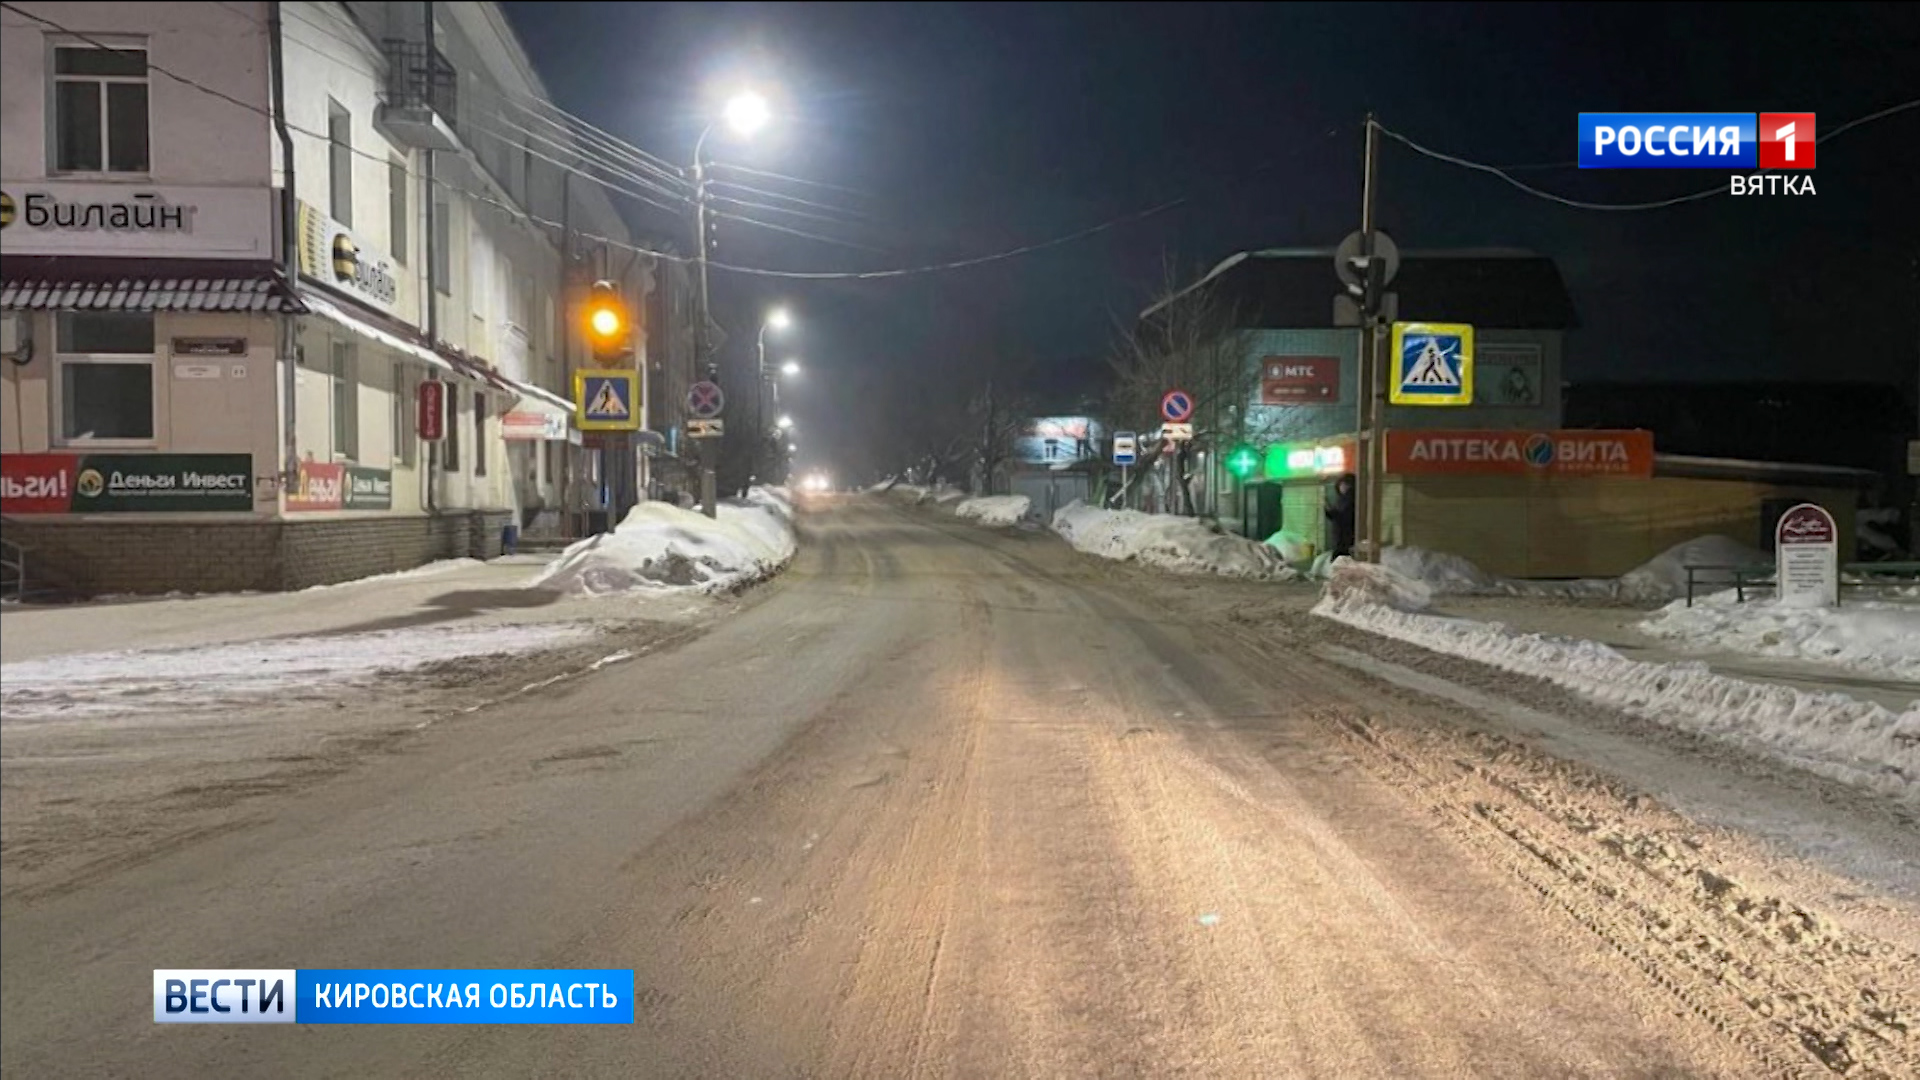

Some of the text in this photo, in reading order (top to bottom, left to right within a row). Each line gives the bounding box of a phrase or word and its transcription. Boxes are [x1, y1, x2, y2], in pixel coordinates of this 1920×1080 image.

[25, 193, 182, 228] Билайн
[1284, 365, 1315, 377] МТС
[1409, 440, 1629, 462] АПТЕКА ВИТА
[109, 471, 246, 488] Деньги Инвест
